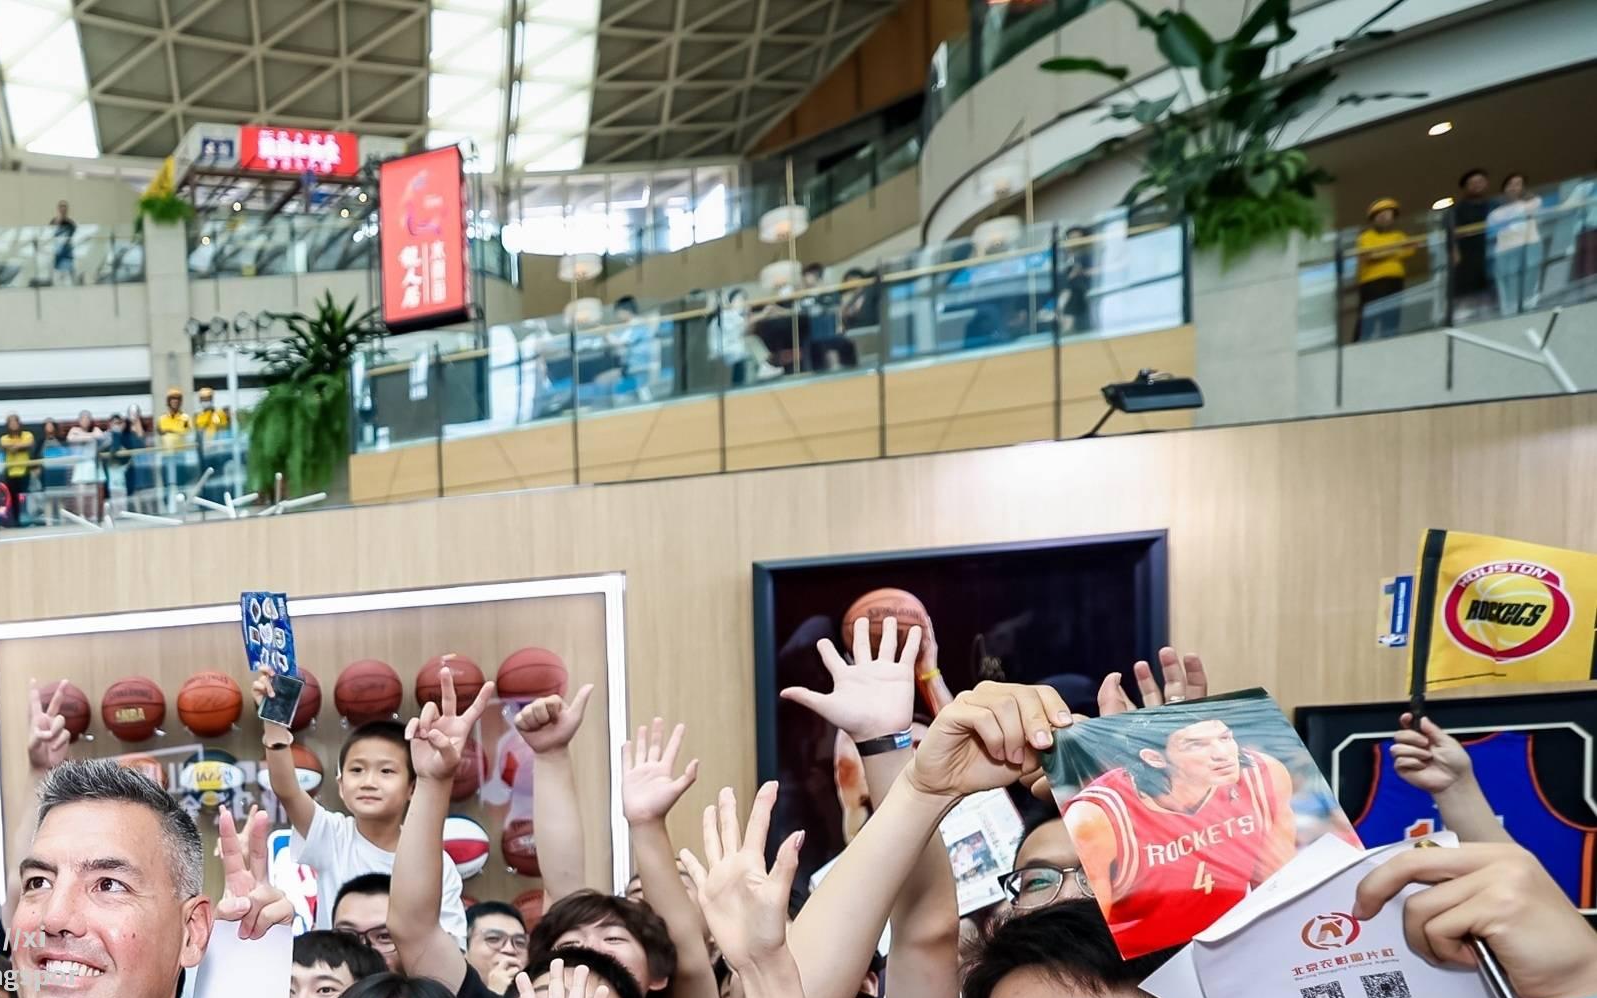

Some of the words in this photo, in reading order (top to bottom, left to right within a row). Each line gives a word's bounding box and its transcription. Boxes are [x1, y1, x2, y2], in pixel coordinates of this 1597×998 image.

[1458, 562, 1548, 588] HOUSTON
[1465, 599, 1547, 627] ROCKETS
[1143, 815, 1255, 868] ROCKETS
[1192, 860, 1215, 895] 4
